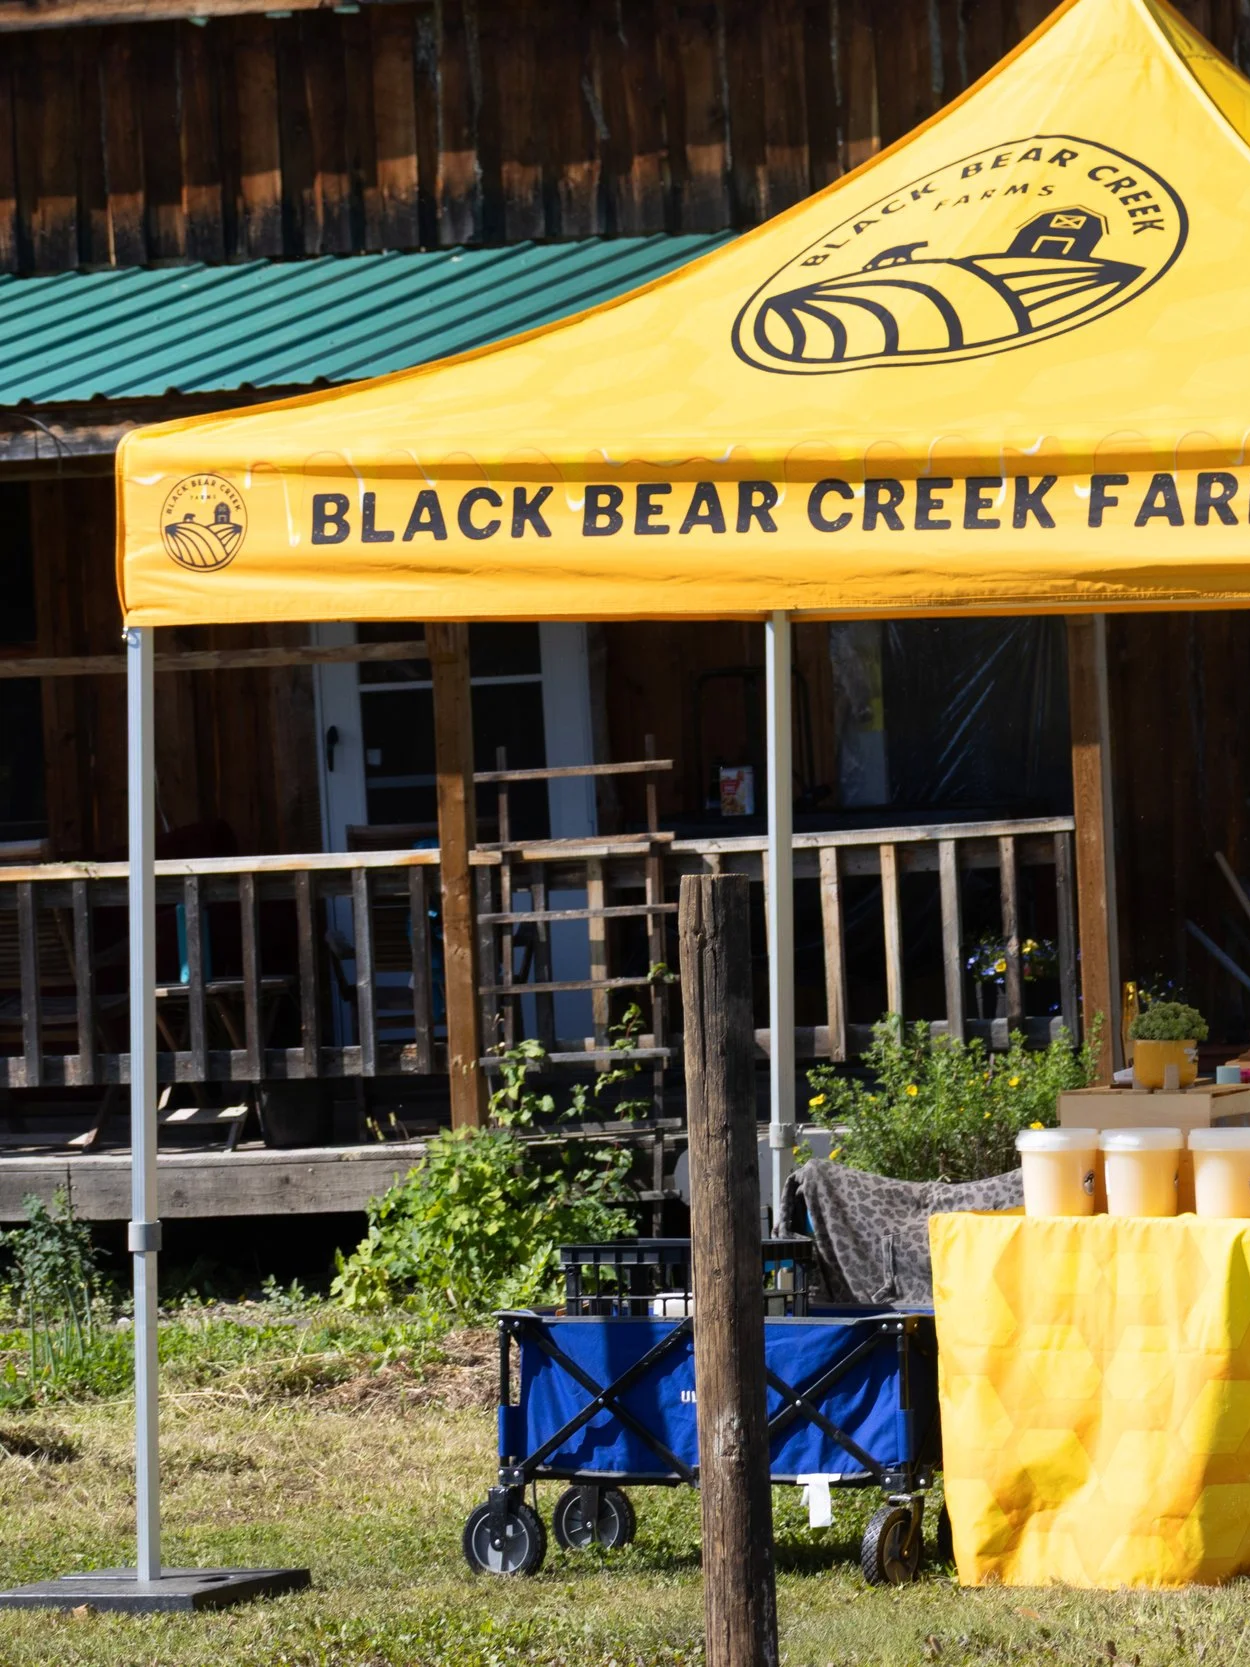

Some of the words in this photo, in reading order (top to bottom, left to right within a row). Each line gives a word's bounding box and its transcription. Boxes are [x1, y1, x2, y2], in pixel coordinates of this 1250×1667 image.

[801, 182, 939, 267] BLACK
[960, 147, 1079, 180] BEAR
[1087, 165, 1165, 236] CREEK
[933, 183, 1056, 212] FARMS
[166, 484, 189, 515] BLACK
[191, 478, 217, 488] BEAR
[219, 484, 242, 512] CREEK
[311, 486, 555, 546] BLACK
[582, 480, 779, 538] BEAR
[807, 474, 1058, 533] CREEK
